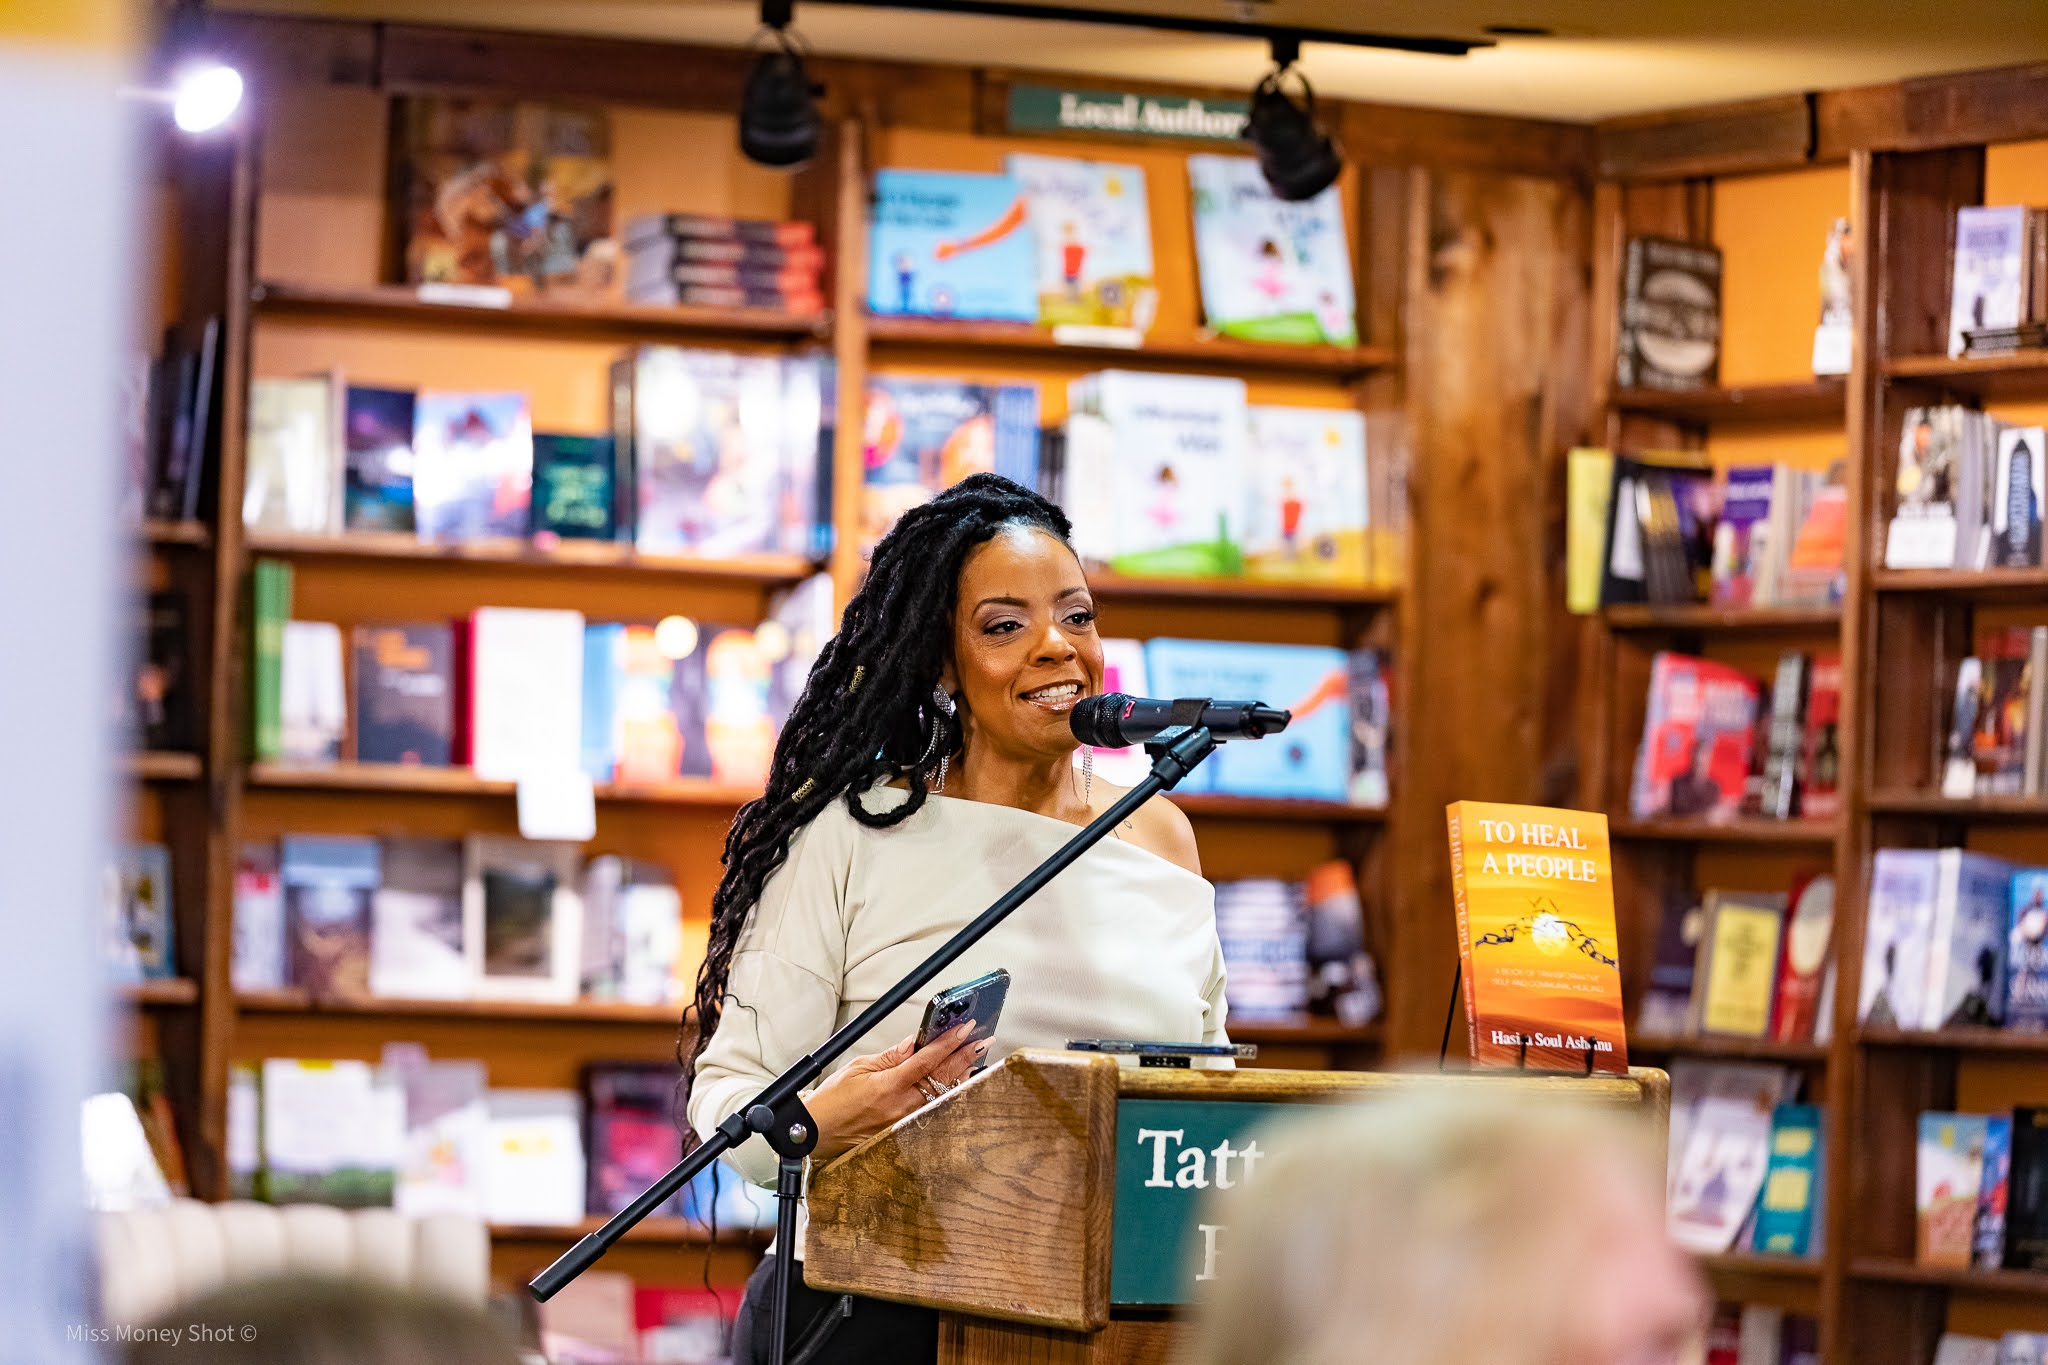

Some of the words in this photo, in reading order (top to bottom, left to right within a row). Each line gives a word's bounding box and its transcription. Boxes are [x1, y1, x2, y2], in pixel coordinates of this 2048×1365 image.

[1060, 94, 1139, 130] Local
[1141, 99, 1248, 138] Author
[1479, 819, 1516, 843] TO
[1521, 823, 1587, 850] HEAL
[1452, 841, 1465, 878] HEAL
[1482, 853, 1500, 874] A
[1506, 853, 1597, 883] PEOPLE
[1457, 903, 1470, 959] PEOPLE
[1491, 1030, 1533, 1047] Hasia
[1534, 1033, 1562, 1049] Soul
[1565, 1035, 1613, 1052] Ashnu
[1137, 1127, 1265, 1190] Tatt
